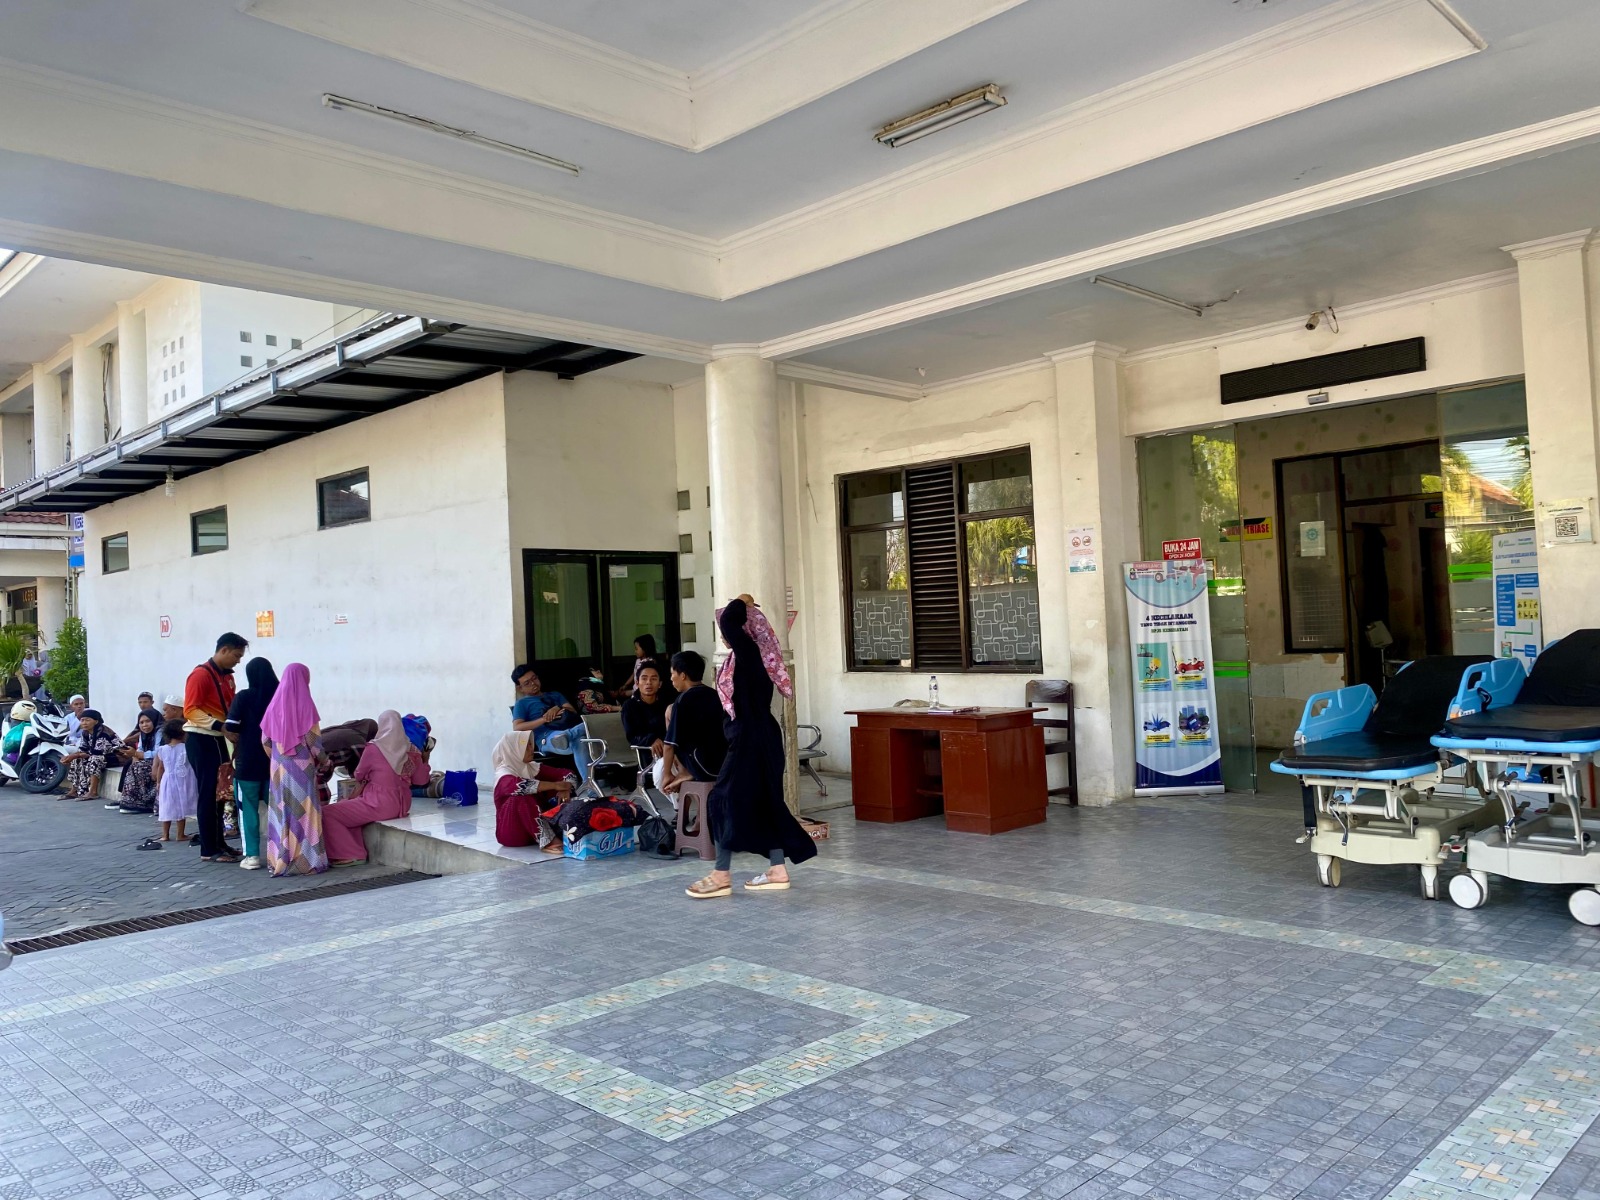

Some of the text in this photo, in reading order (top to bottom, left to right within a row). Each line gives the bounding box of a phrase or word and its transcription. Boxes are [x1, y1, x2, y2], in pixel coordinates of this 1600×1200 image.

[1246, 524, 1270, 534] TRIASE
[1164, 540, 1199, 553] BUKA 24 JAM
[599, 831, 624, 852] GH
